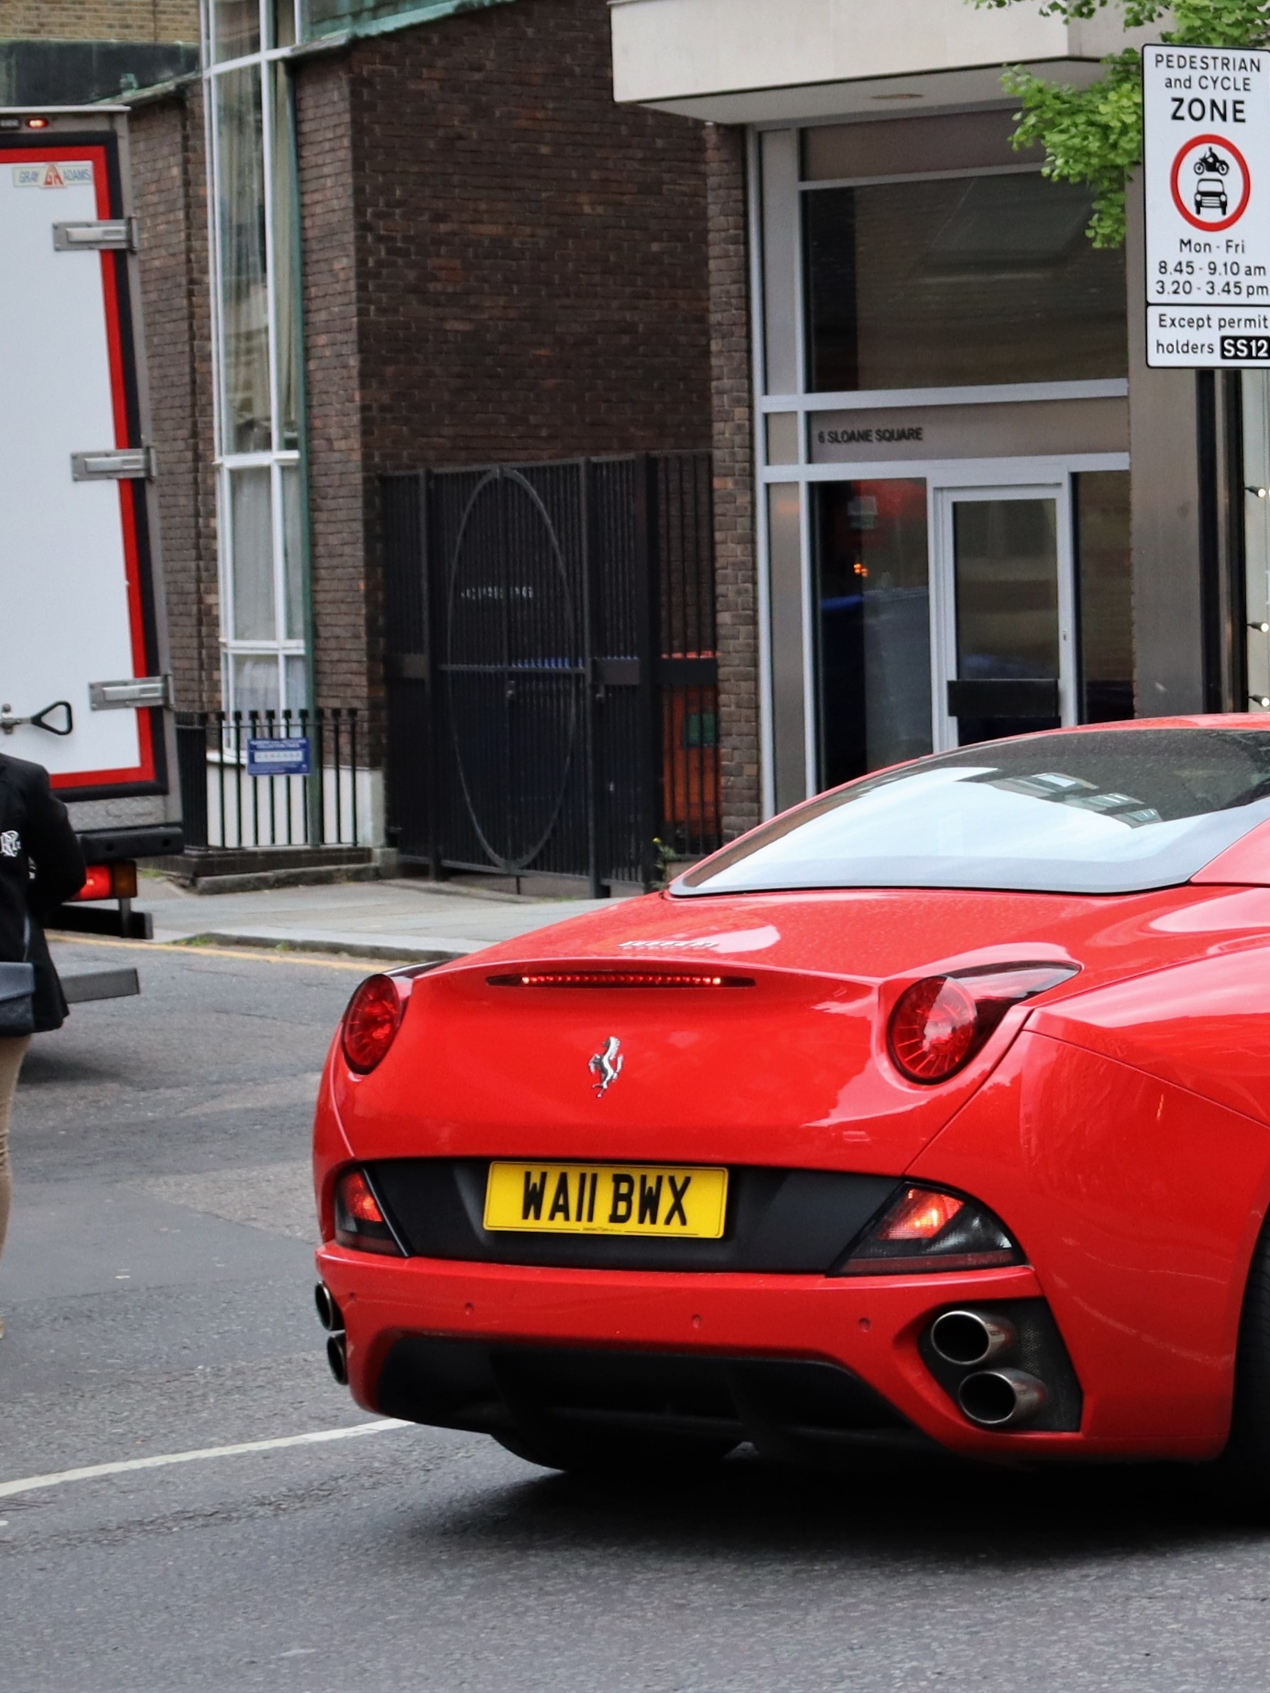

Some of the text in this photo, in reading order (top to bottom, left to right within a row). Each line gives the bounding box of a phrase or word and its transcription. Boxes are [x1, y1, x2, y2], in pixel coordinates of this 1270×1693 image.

[1154, 53, 1261, 72] PEDESTRIAN
[1164, 75, 1252, 92] and CYCLE
[1170, 97, 1246, 123] ZONE
[1179, 238, 1213, 254] Mon
[1224, 239, 1246, 255] Fri
[1158, 260, 1196, 276] 8.45
[1207, 261, 1241, 277] 9.10
[1244, 265, 1267, 277] am
[1155, 279, 1193, 295] 3.20
[1205, 280, 1243, 296] 3.45
[1246, 284, 1270, 298] pm
[1158, 313, 1270, 331] Except permit
[1156, 338, 1269, 358] holders SS12
[818, 427, 923, 444] 6 SLOANE SQUARE
[608, 1173, 692, 1227] BWX
